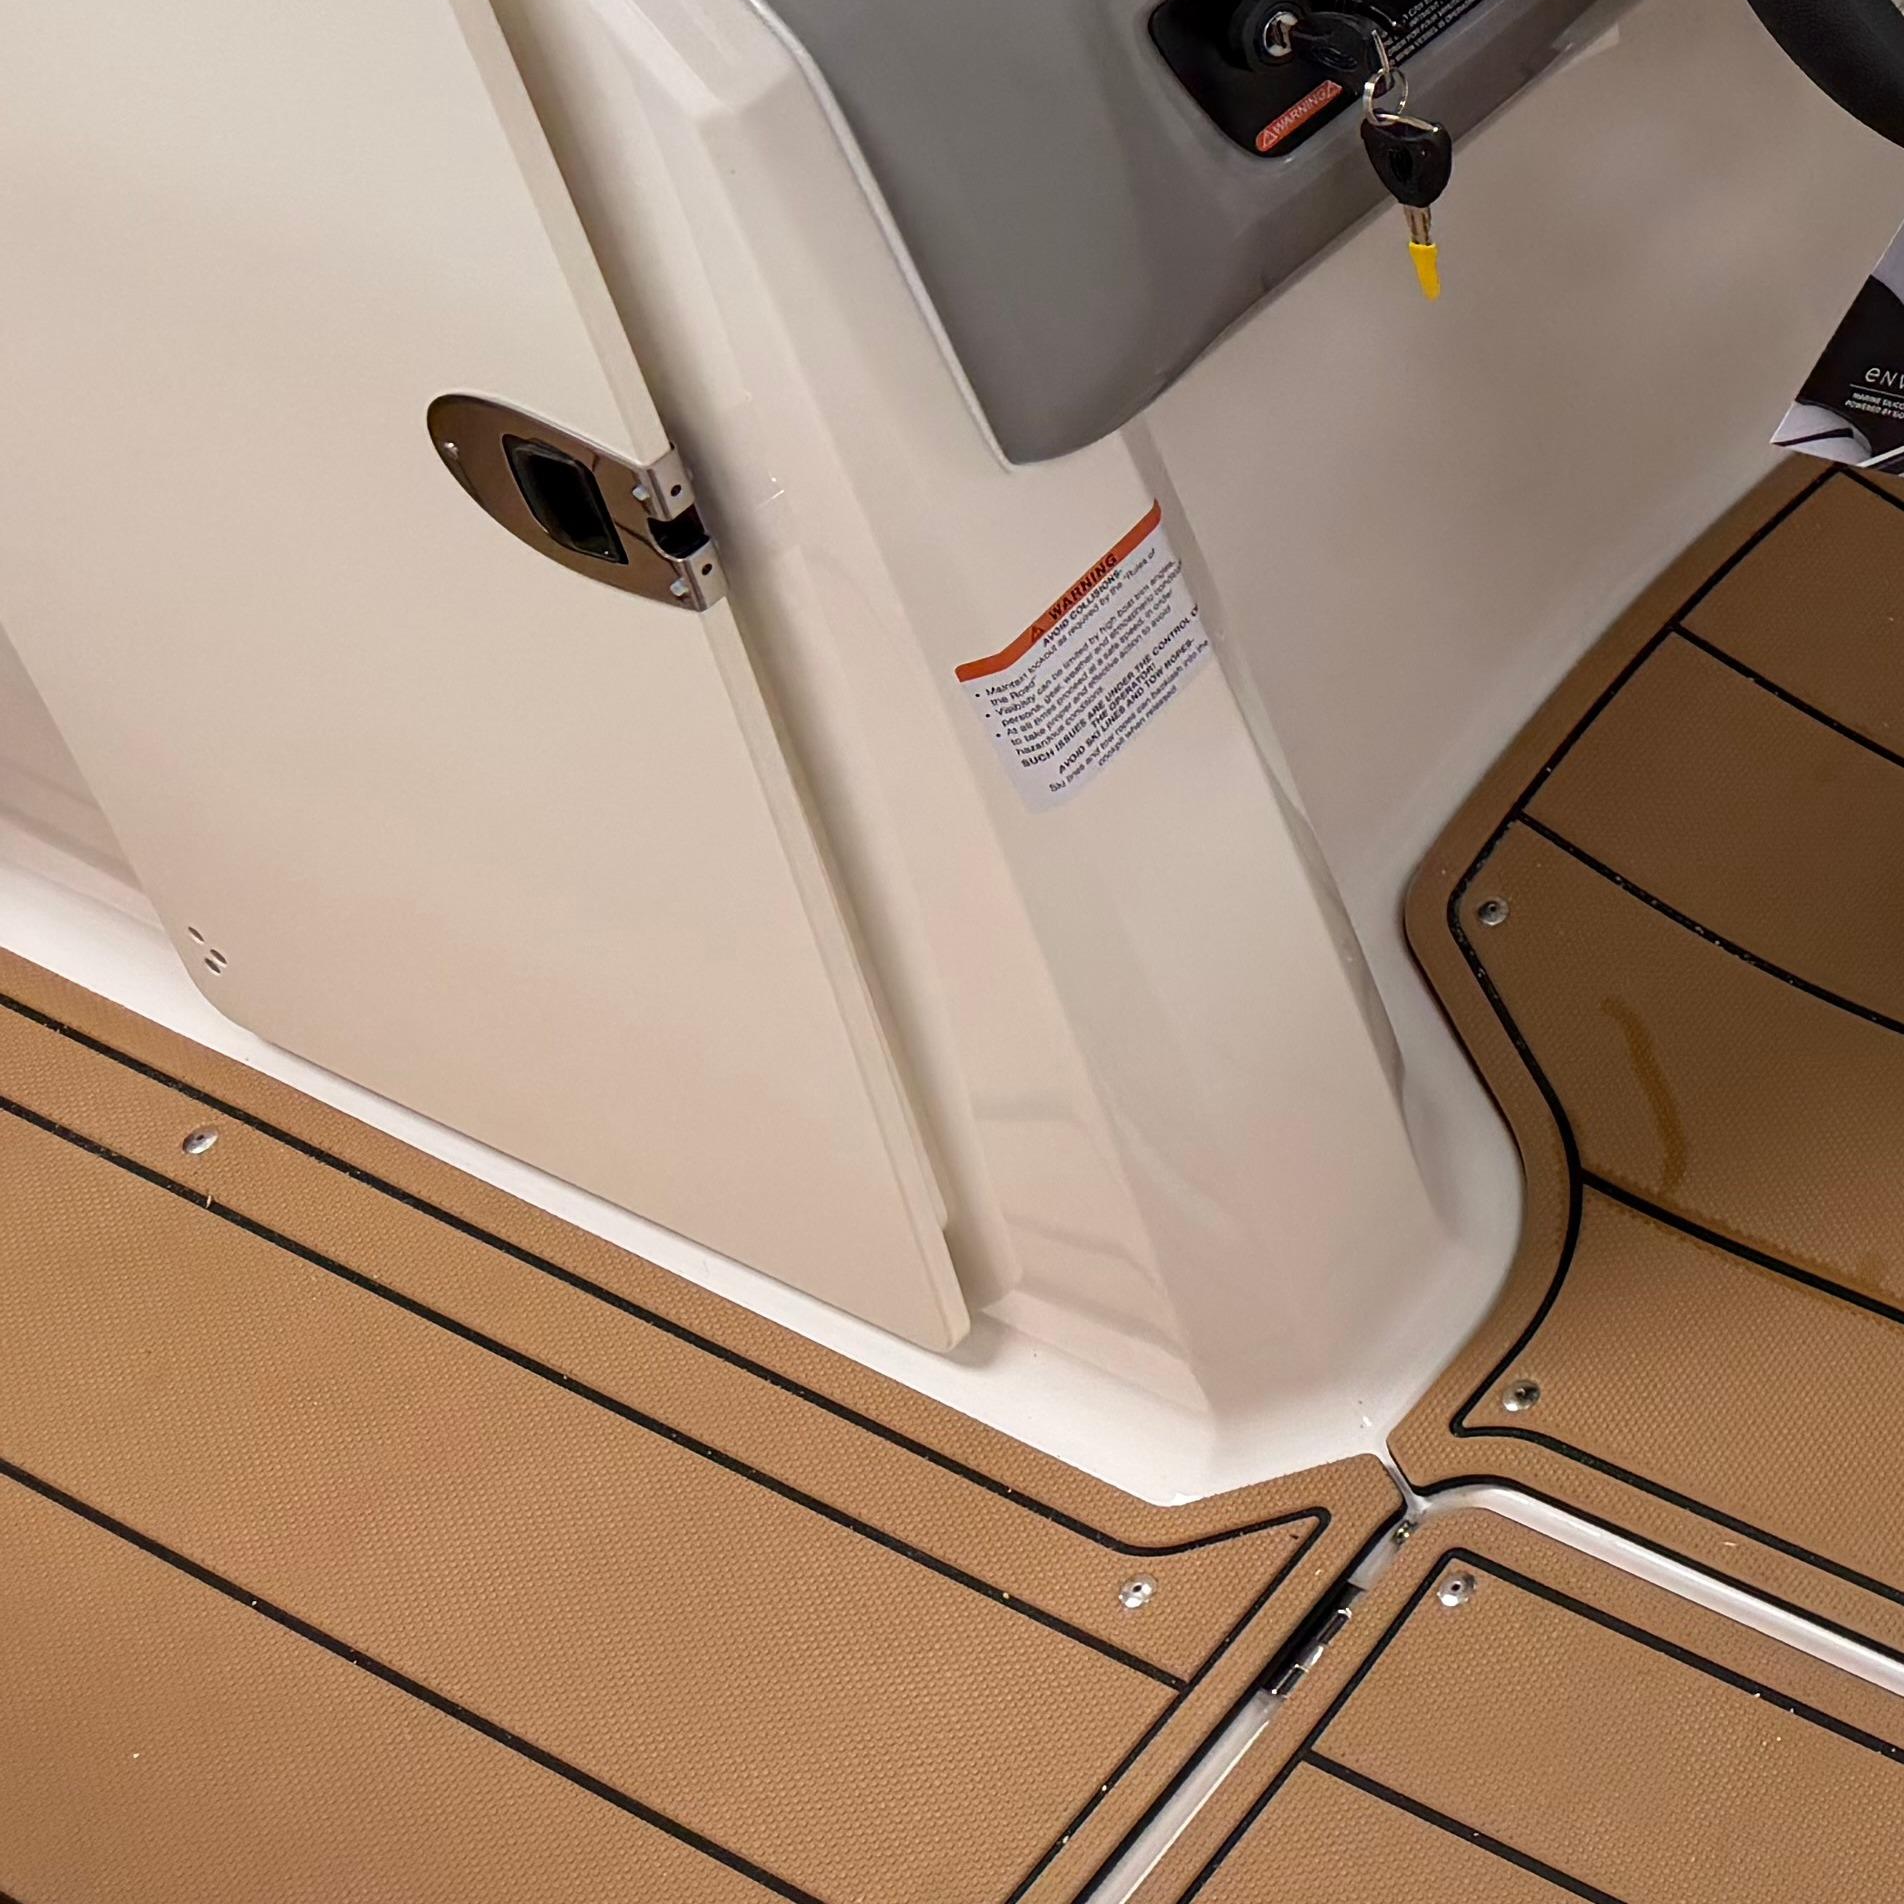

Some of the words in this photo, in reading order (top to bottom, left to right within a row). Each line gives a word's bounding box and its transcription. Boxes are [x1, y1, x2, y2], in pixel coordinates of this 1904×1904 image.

[1272, 89, 1326, 136] WARNING
[1049, 554, 1117, 620] WARNING
[986, 673, 1028, 695] Maintain
[1028, 646, 1058, 674] lookout
[1069, 606, 1101, 637] required
[1101, 594, 1111, 607] by
[1110, 581, 1123, 595] the
[1148, 549, 1158, 560] of
[1037, 678, 1052, 694] can
[1052, 668, 1063, 679] be
[1064, 644, 1090, 669] limited
[1089, 633, 1100, 645] by
[1100, 616, 1117, 634] high
[1042, 619, 1070, 646] AVOID
[1095, 639, 1110, 654] and
[1103, 642, 1120, 659] safe
[1153, 590, 1175, 610] order
[992, 697, 1009, 707] the
[1022, 750, 1055, 767] SUCH
[1055, 719, 1088, 750] ISSUES
[1087, 701, 1106, 719] ARE
[1106, 673, 1135, 701] UNDER
[1136, 655, 1153, 672] THE
[1153, 617, 1190, 655] CONTROL
[1024, 727, 1046, 741] take
[1073, 687, 1089, 703] and
[1120, 635, 1143, 658] action
[1152, 606, 1173, 627] avoid
[1050, 782, 1066, 792] Ski
[1115, 713, 1137, 735] ropes
[1137, 698, 1152, 713] can
[1057, 746, 1086, 772] AVOID
[1086, 731, 1101, 746] SKI
[1101, 706, 1127, 732] LINES
[1126, 687, 1145, 706] AND
[1145, 669, 1164, 687] TOW
[1092, 711, 1110, 727] THE
[1125, 718, 1147, 738] when
